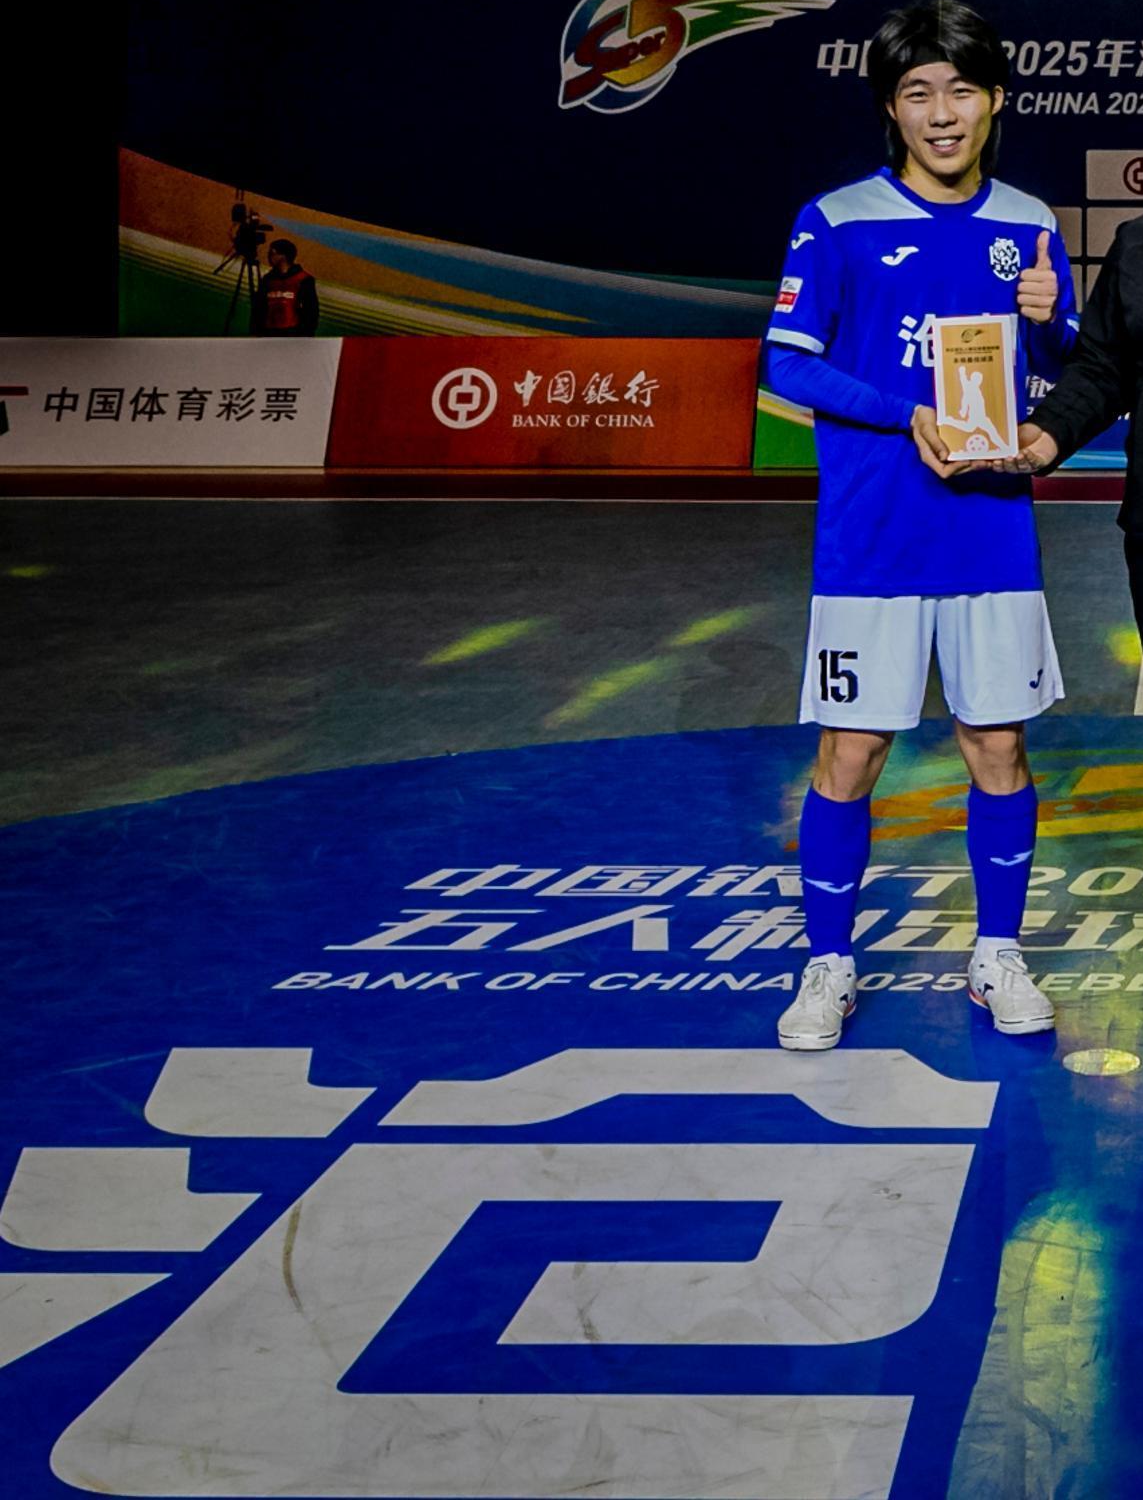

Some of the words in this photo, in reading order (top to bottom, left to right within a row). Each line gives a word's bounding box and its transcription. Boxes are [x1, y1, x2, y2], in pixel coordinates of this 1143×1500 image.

[1017, 92, 1100, 115] CHINA
[44, 386, 301, 422] 中国体育彩票
[512, 414, 562, 428] BANK
[566, 414, 591, 428] OF
[595, 414, 655, 428] CHINA
[819, 649, 858, 703] 15
[271, 972, 483, 990] BANK
[485, 972, 585, 990] OF
[588, 972, 794, 991] CHINA
[857, 972, 971, 992] 025
